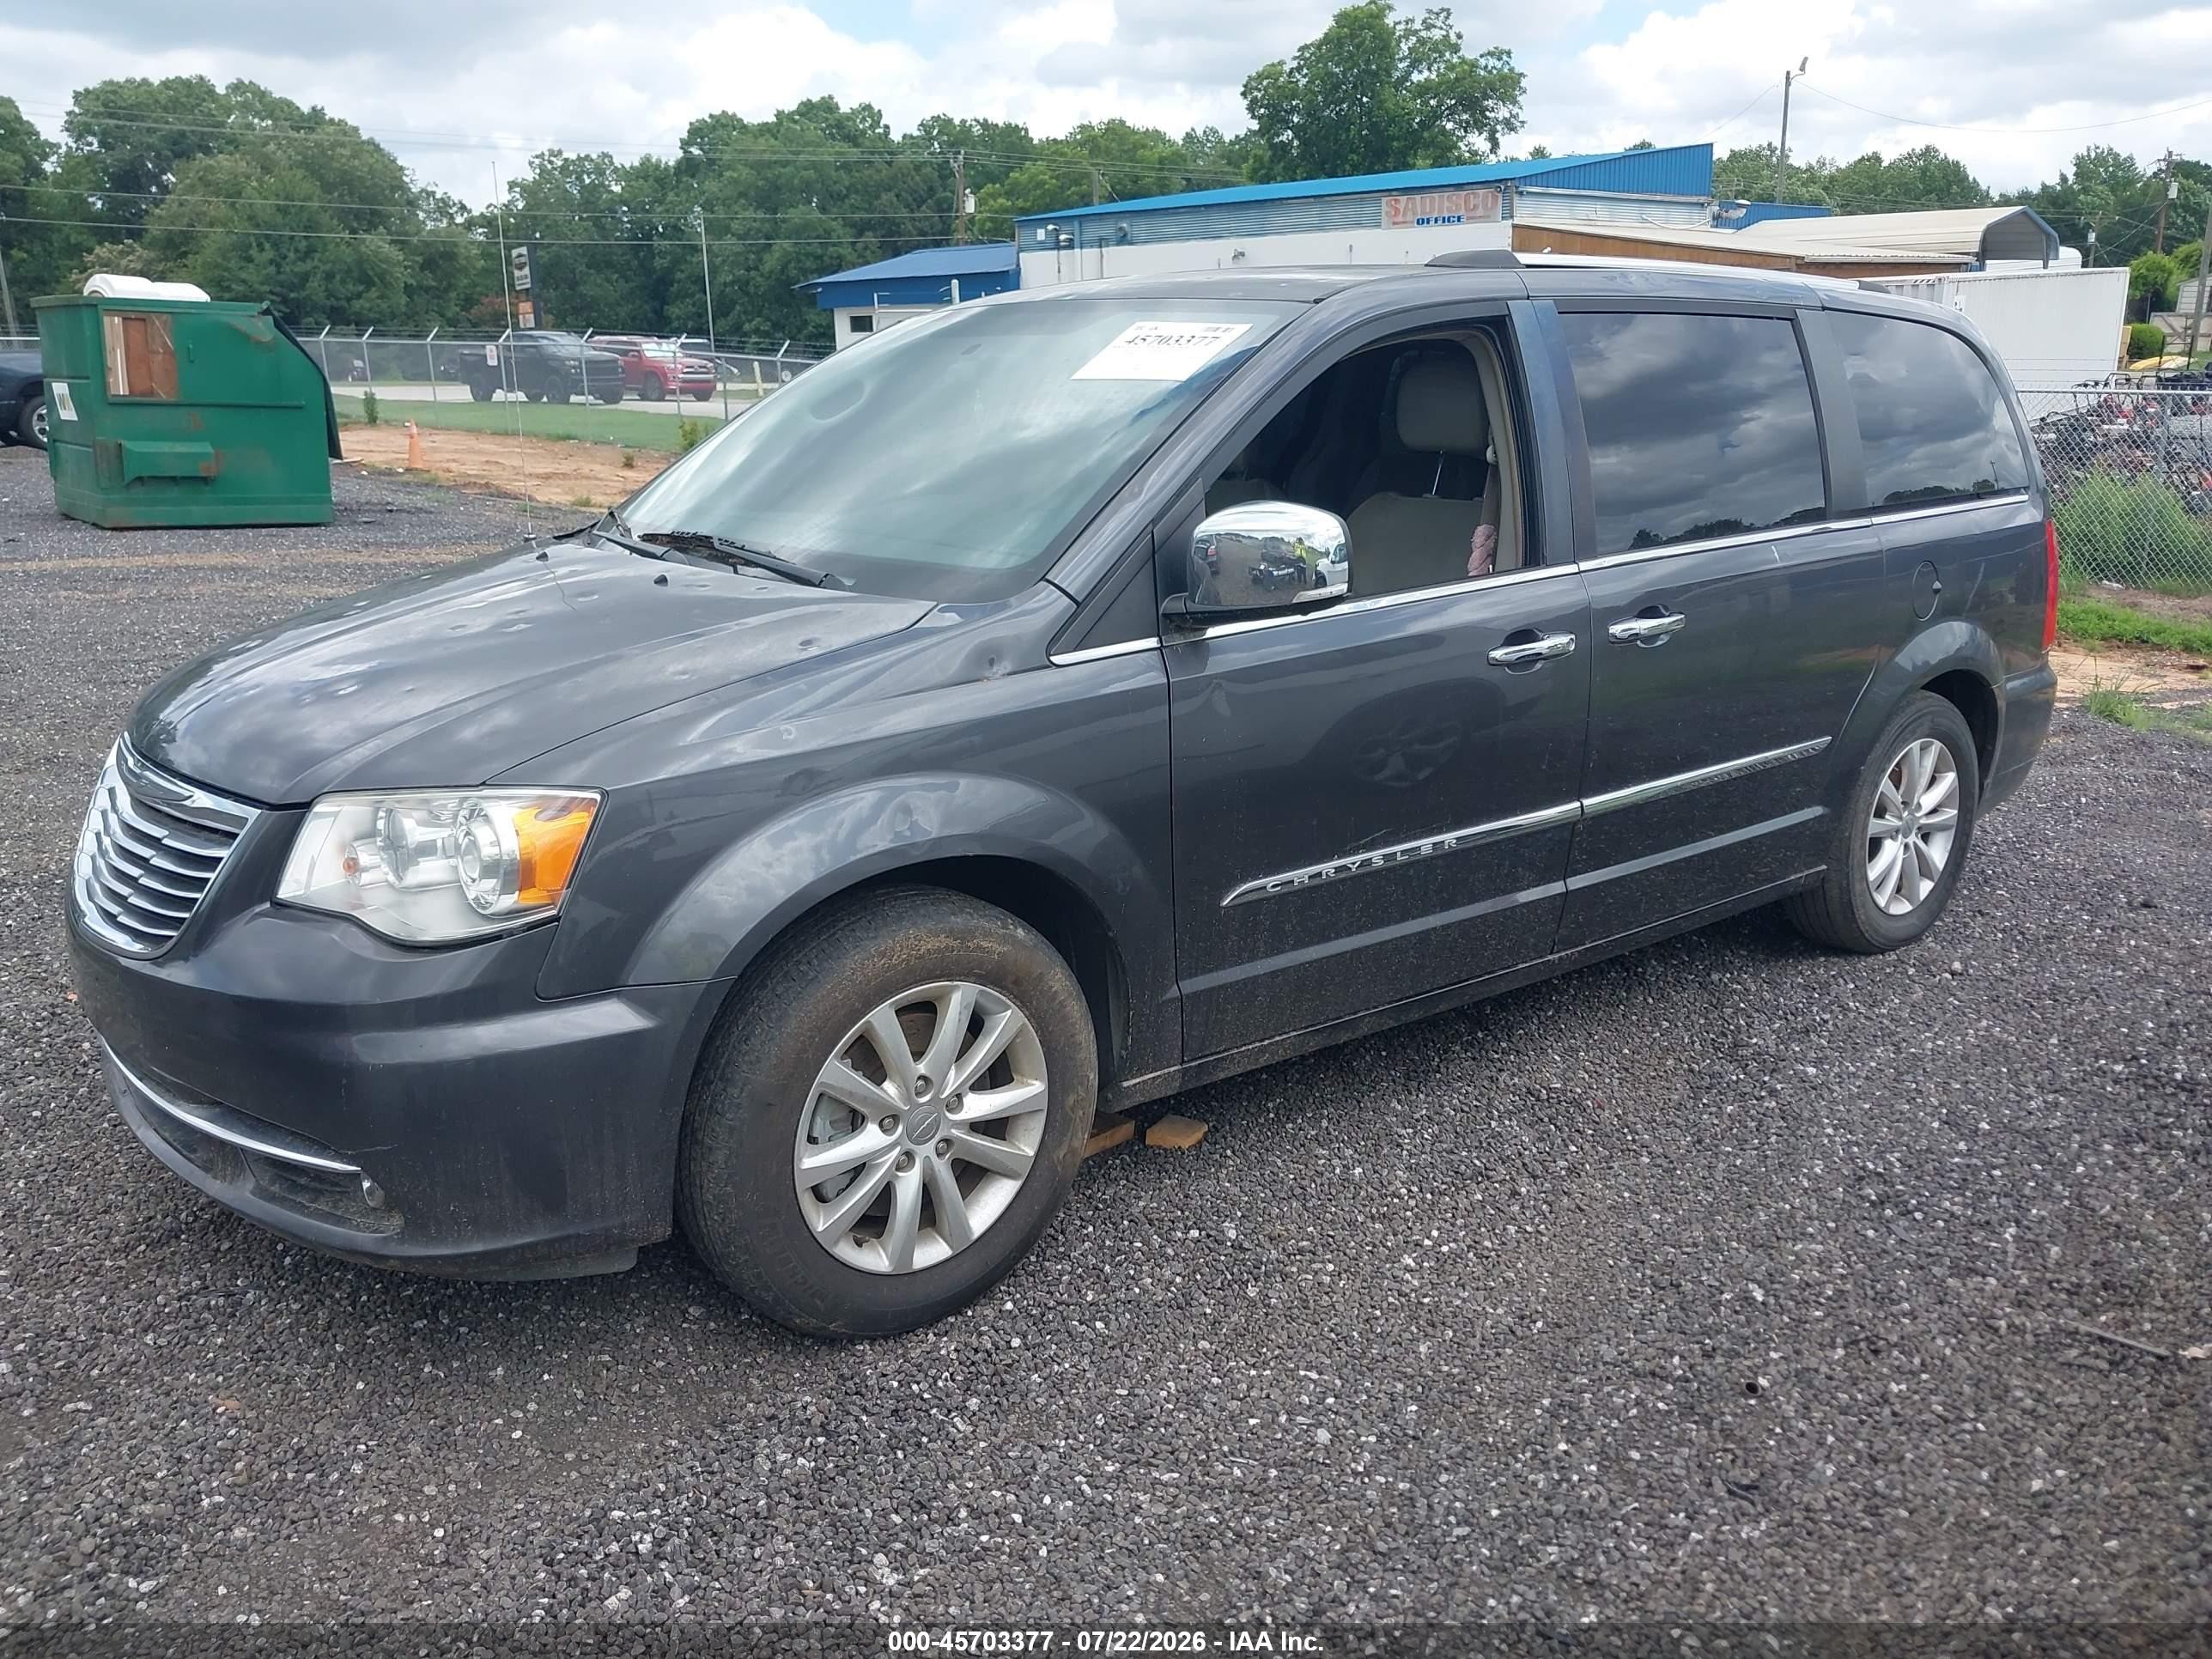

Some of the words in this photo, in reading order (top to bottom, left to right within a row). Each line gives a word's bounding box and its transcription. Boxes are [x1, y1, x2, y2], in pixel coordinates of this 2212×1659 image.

[1385, 191, 1499, 218] SADISCO
[1416, 215, 1466, 226] OFFICE
[1124, 335, 1221, 345] 45703377
[1266, 838, 1458, 892] CHRYSLER
